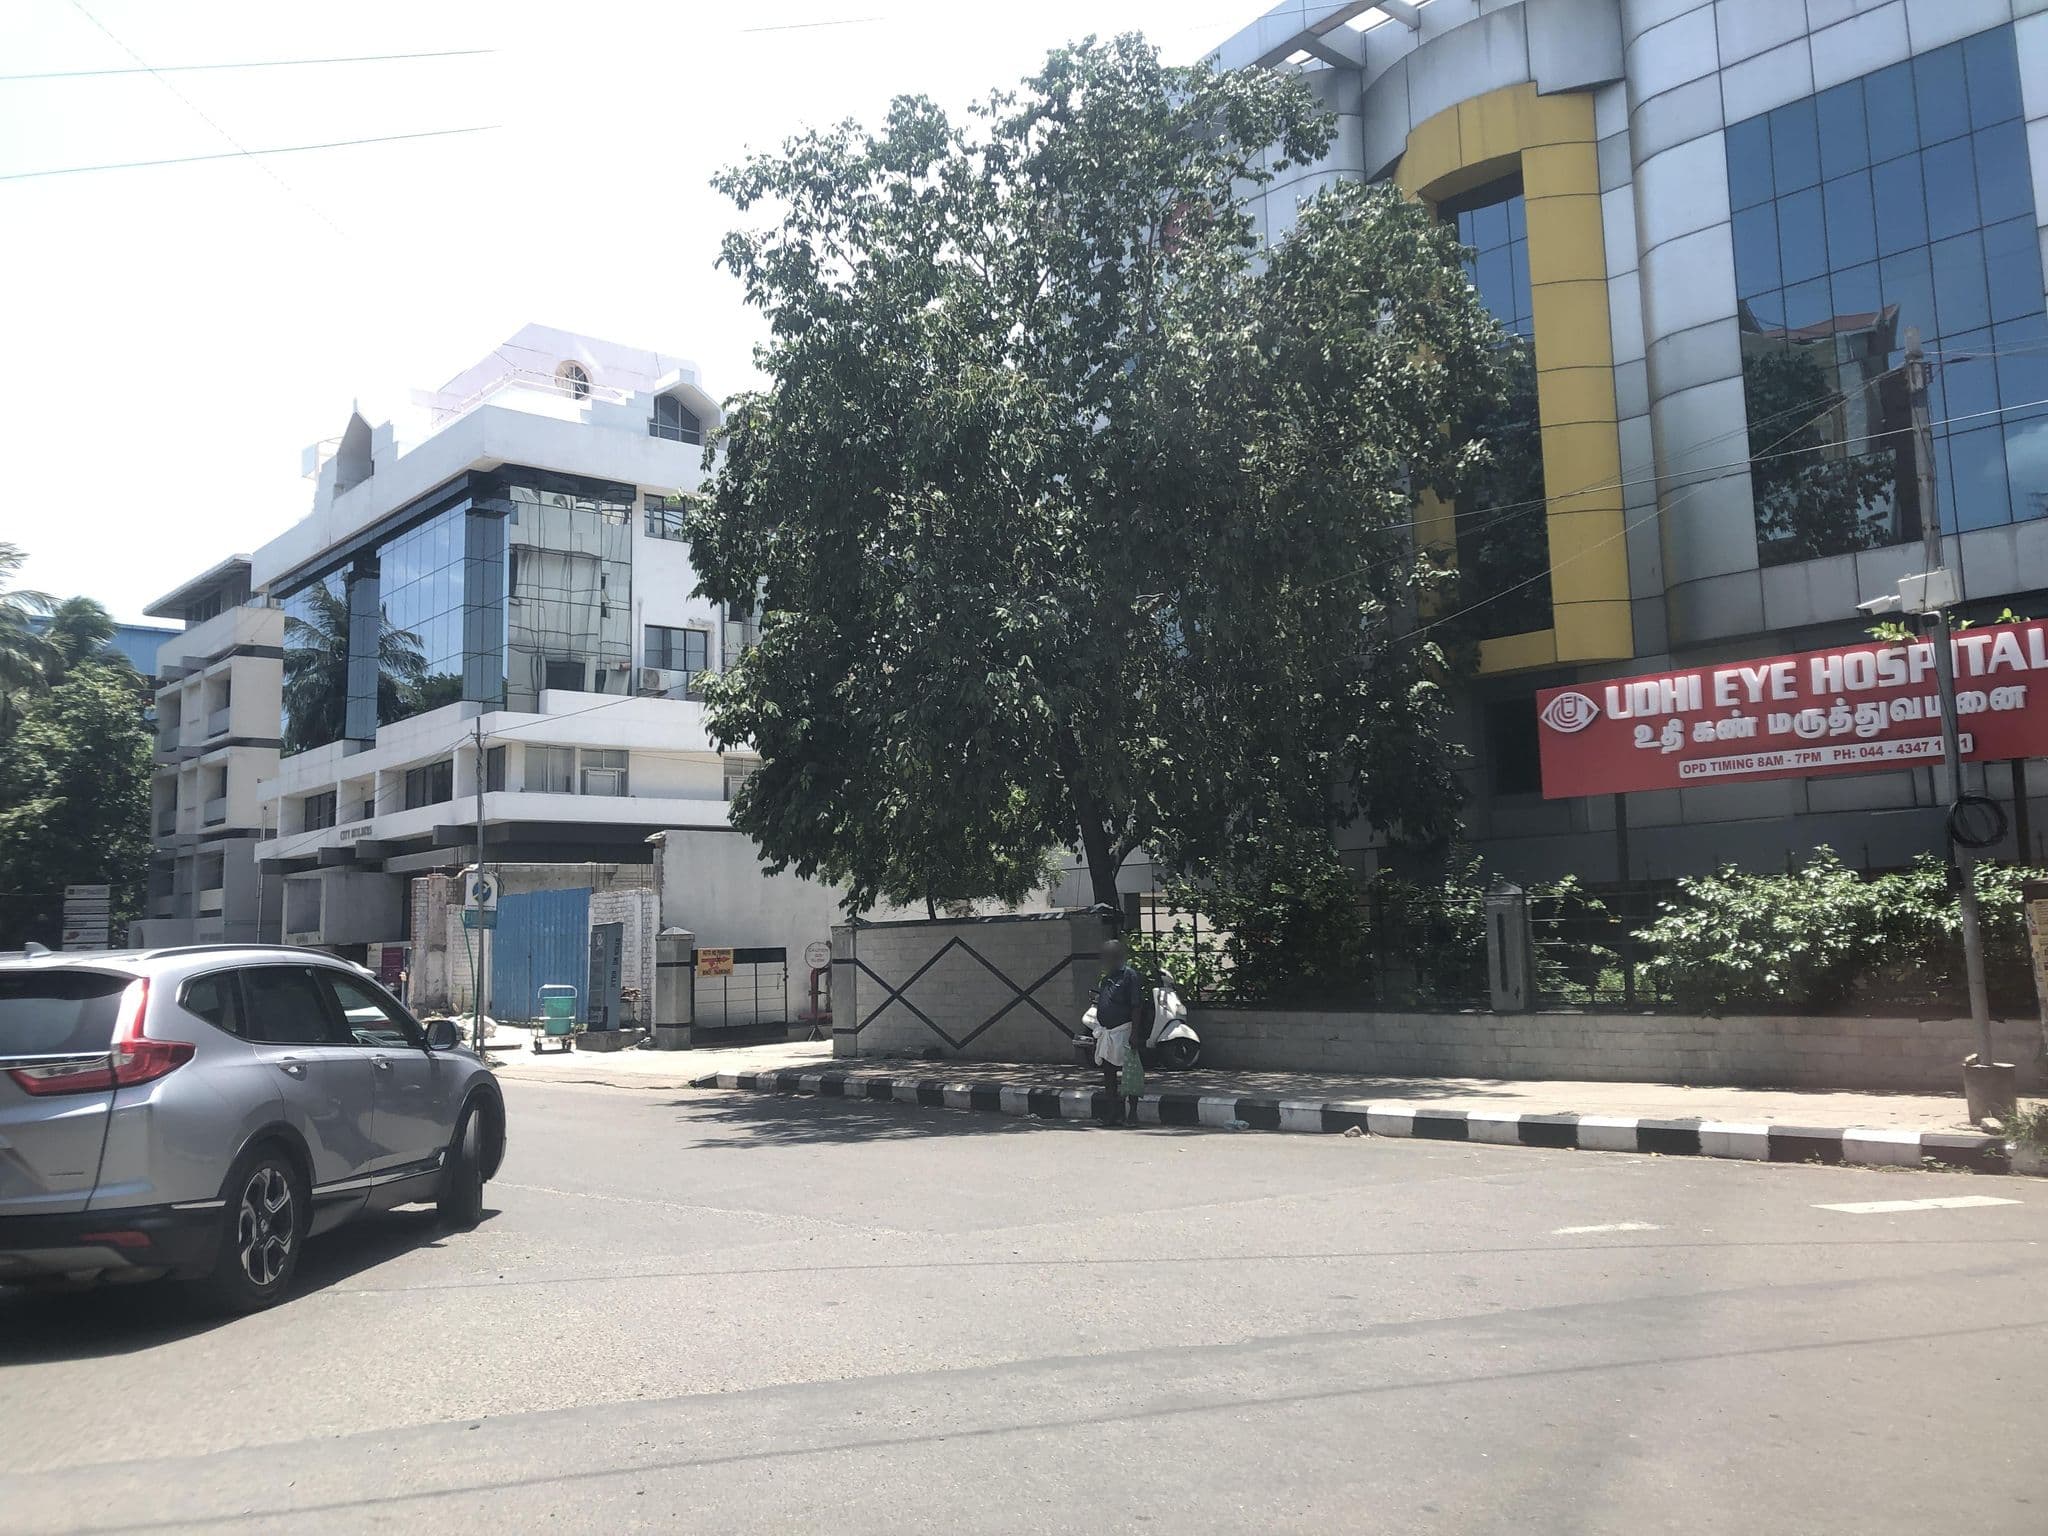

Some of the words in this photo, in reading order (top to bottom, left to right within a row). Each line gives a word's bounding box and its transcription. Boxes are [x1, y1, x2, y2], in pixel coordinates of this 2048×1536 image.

[1605, 674, 1703, 720] UDHI
[1713, 661, 1798, 707] EYE
[1810, 627, 2048, 695] HOSPITAL
[1634, 718, 1686, 754] உதி
[1692, 708, 1759, 743] கண்
[1682, 763, 1707, 775] OPD
[1710, 758, 1754, 773] TIMING
[1757, 755, 1784, 768] 8AM
[1795, 751, 1822, 764] 7PM
[1833, 749, 1856, 760] PH:
[1860, 745, 1884, 758] 044
[1896, 741, 1930, 755] 4347
